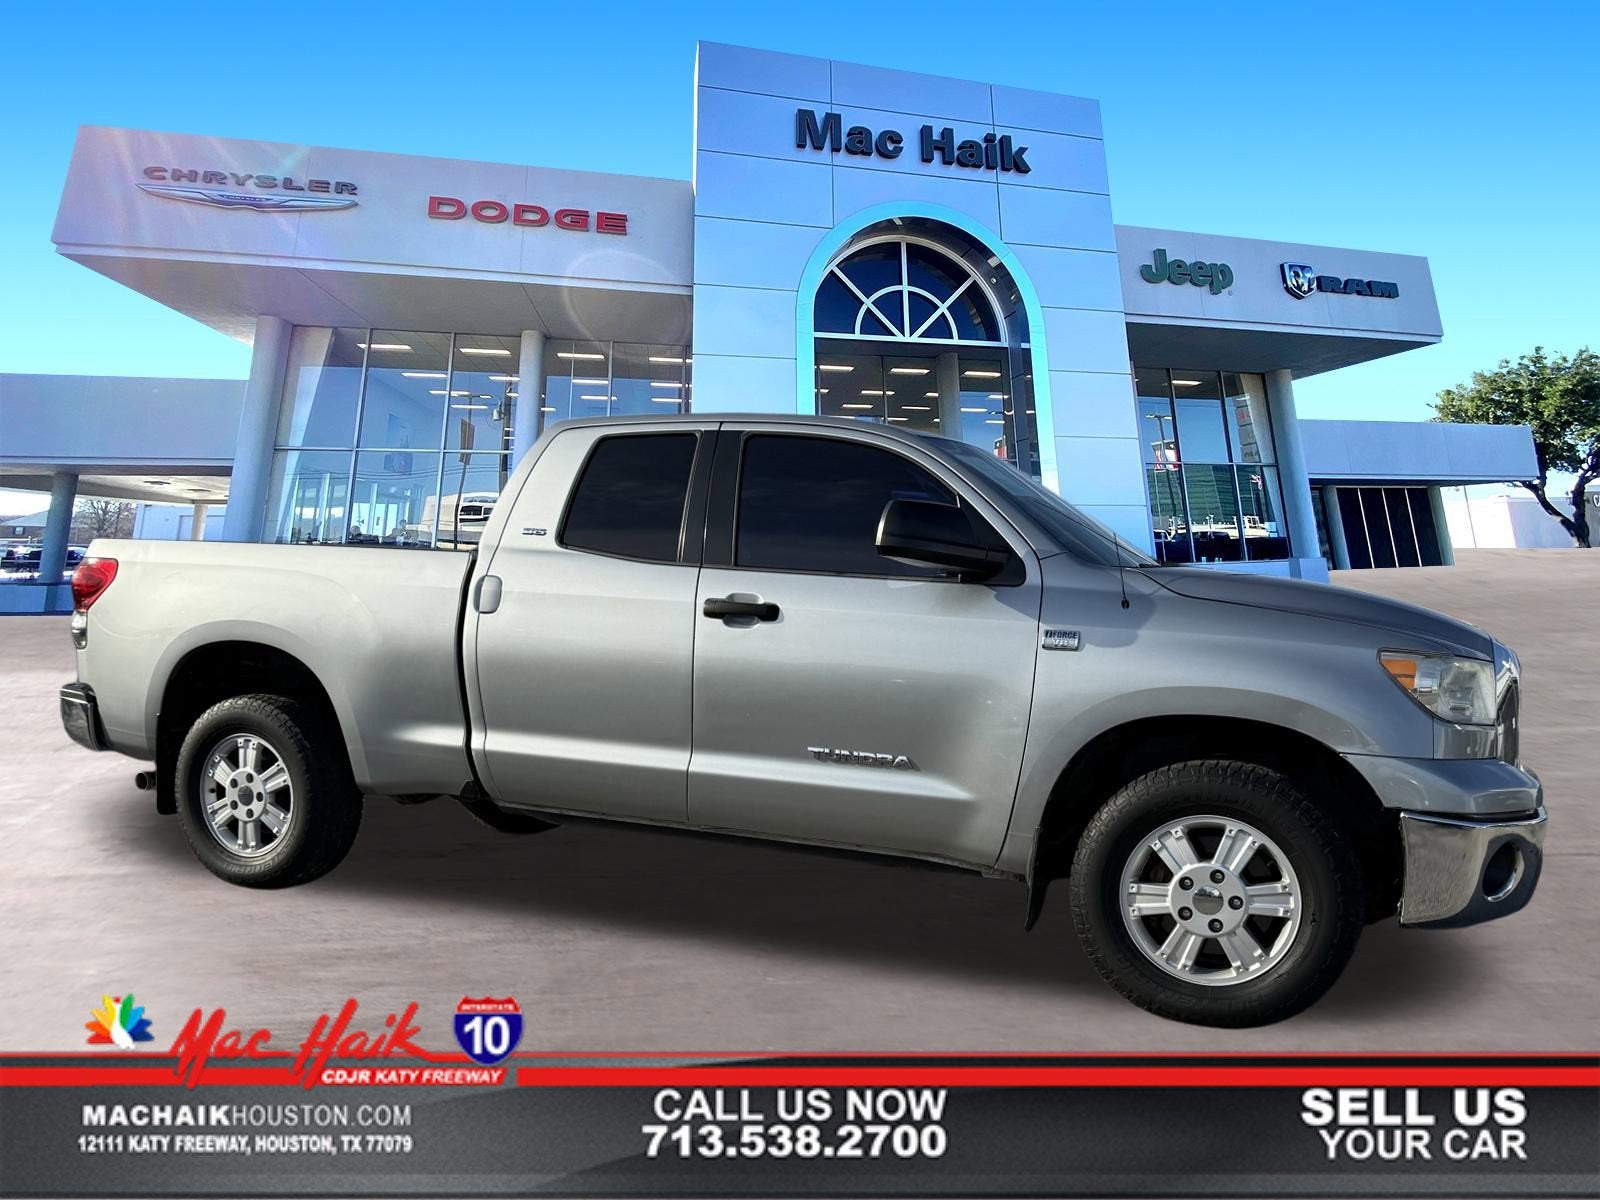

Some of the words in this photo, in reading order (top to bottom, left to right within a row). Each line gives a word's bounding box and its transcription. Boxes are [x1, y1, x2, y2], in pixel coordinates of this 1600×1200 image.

[796, 109, 904, 159] Mac
[920, 125, 1032, 174] Haik
[143, 166, 358, 195] CHRYSLER
[428, 196, 628, 235] DODGE
[1140, 248, 1234, 295] Jeep
[1315, 276, 1399, 298] RAM
